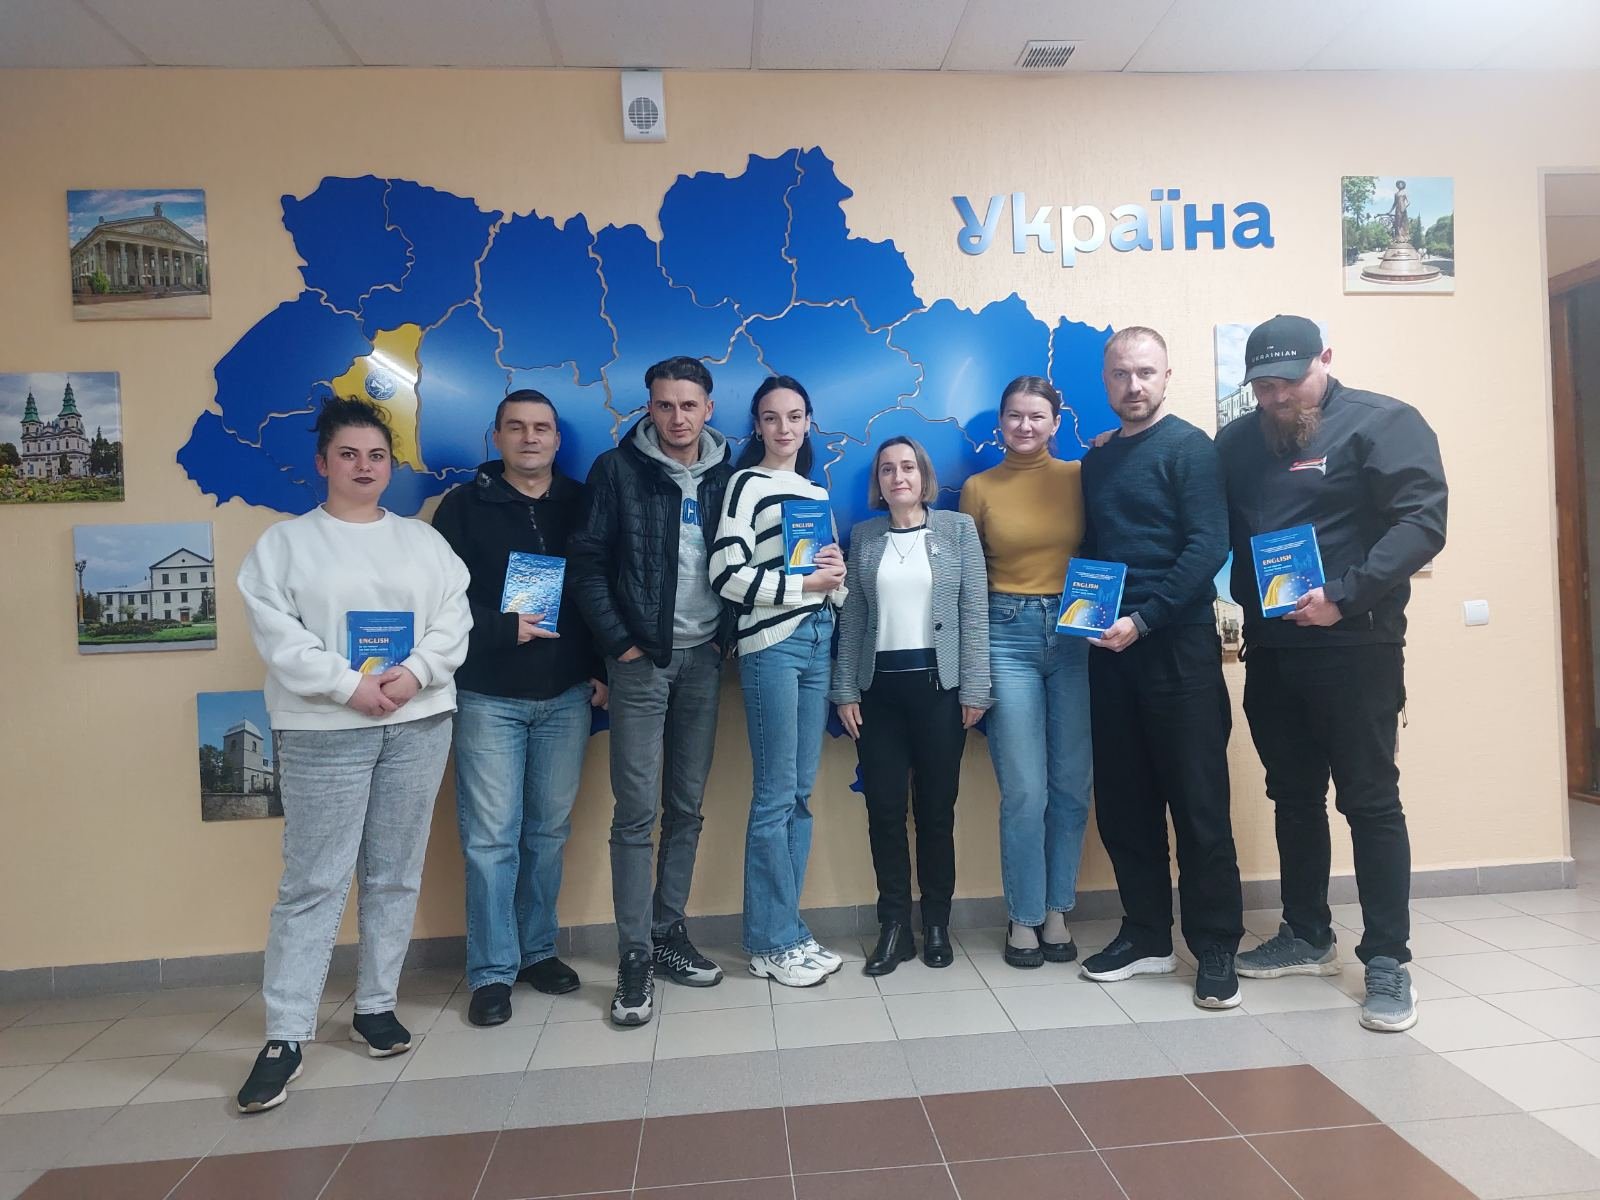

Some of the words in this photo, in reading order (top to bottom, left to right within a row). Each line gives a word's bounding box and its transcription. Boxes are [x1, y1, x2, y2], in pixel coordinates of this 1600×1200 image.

[952, 188, 1275, 268] Україна
[1262, 554, 1292, 566] ENGLISH
[1072, 581, 1099, 589] ENGLISH
